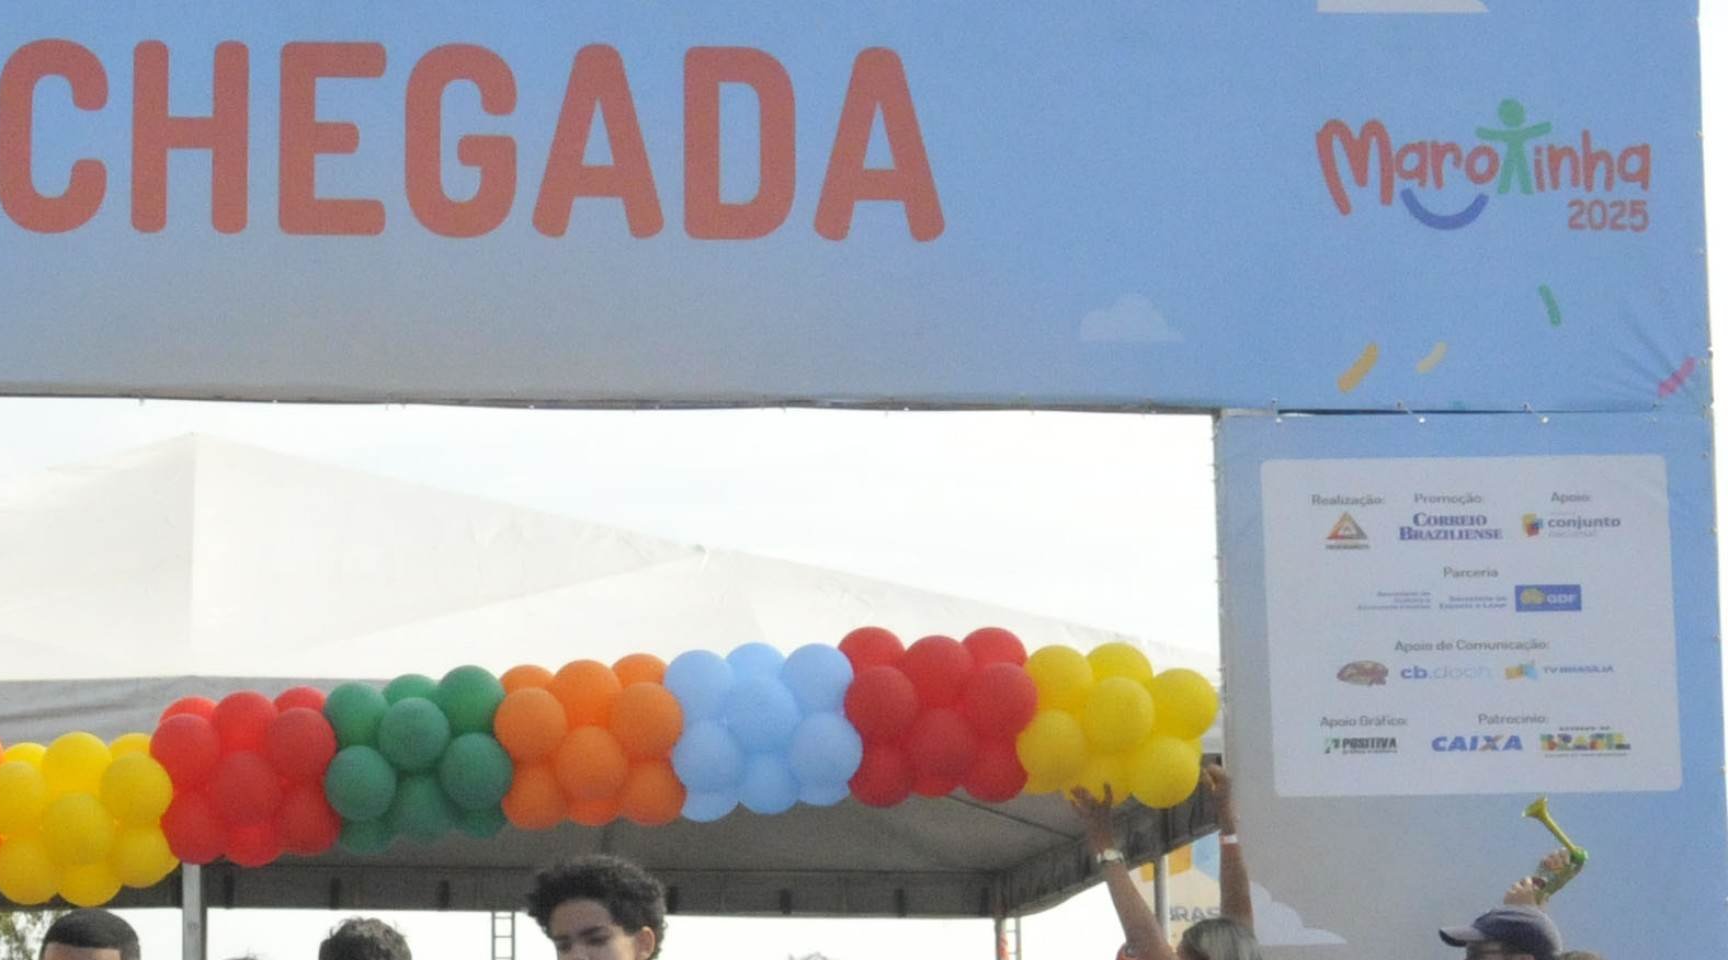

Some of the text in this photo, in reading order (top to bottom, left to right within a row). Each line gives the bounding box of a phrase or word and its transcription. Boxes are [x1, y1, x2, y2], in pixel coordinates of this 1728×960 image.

[1315, 98, 1652, 216] Marotinha
[1568, 200, 1650, 232] 2025
[1413, 512, 1488, 527] CORREIO
[1548, 515, 1621, 530] conjunto
[1399, 526, 1503, 541] BRAZILIENSE
[1443, 566, 1499, 578] Parceria
[1395, 640, 1432, 653] Apoio
[1320, 716, 1356, 728] Apoio
[1342, 737, 1398, 749] POSITIVA
[1432, 736, 1523, 752] CAIXA
